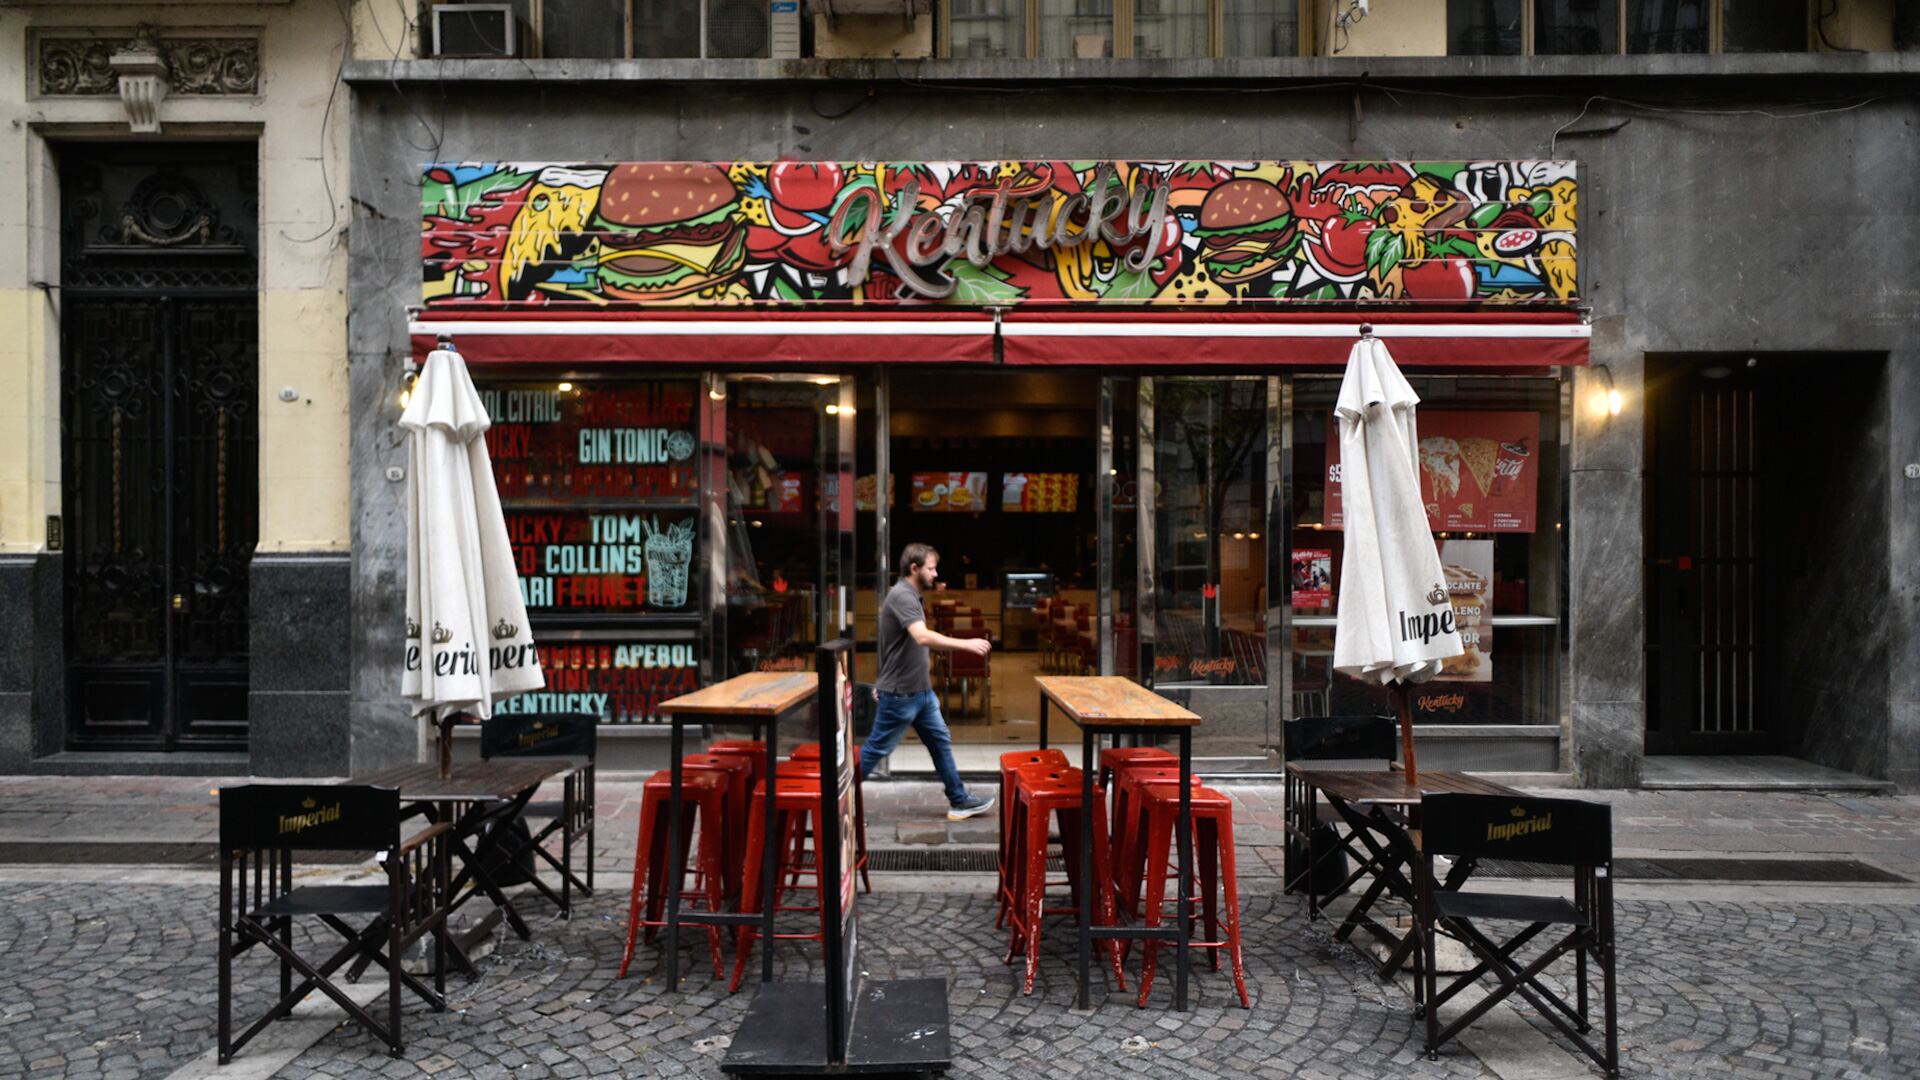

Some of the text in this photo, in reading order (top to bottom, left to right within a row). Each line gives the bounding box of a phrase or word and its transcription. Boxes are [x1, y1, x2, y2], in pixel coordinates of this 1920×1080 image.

[829, 160, 1171, 298] Kentucky
[508, 389, 562, 423] CITRIC
[486, 425, 531, 458] UCKY
[579, 428, 668, 463] GIN TONIC
[590, 515, 640, 544] TOM
[545, 545, 642, 574] COLLINS
[519, 577, 647, 607] ARI FERNET
[1446, 582, 1481, 591] OCANTE
[1454, 606, 1481, 616] LENO
[1399, 608, 1456, 645] Impe
[615, 645, 699, 668] APEROL
[547, 669, 698, 691] TINI CERVEZA
[1417, 693, 1465, 712] Kentucky
[278, 802, 341, 834] Imperial
[1486, 812, 1553, 841] Imperial
